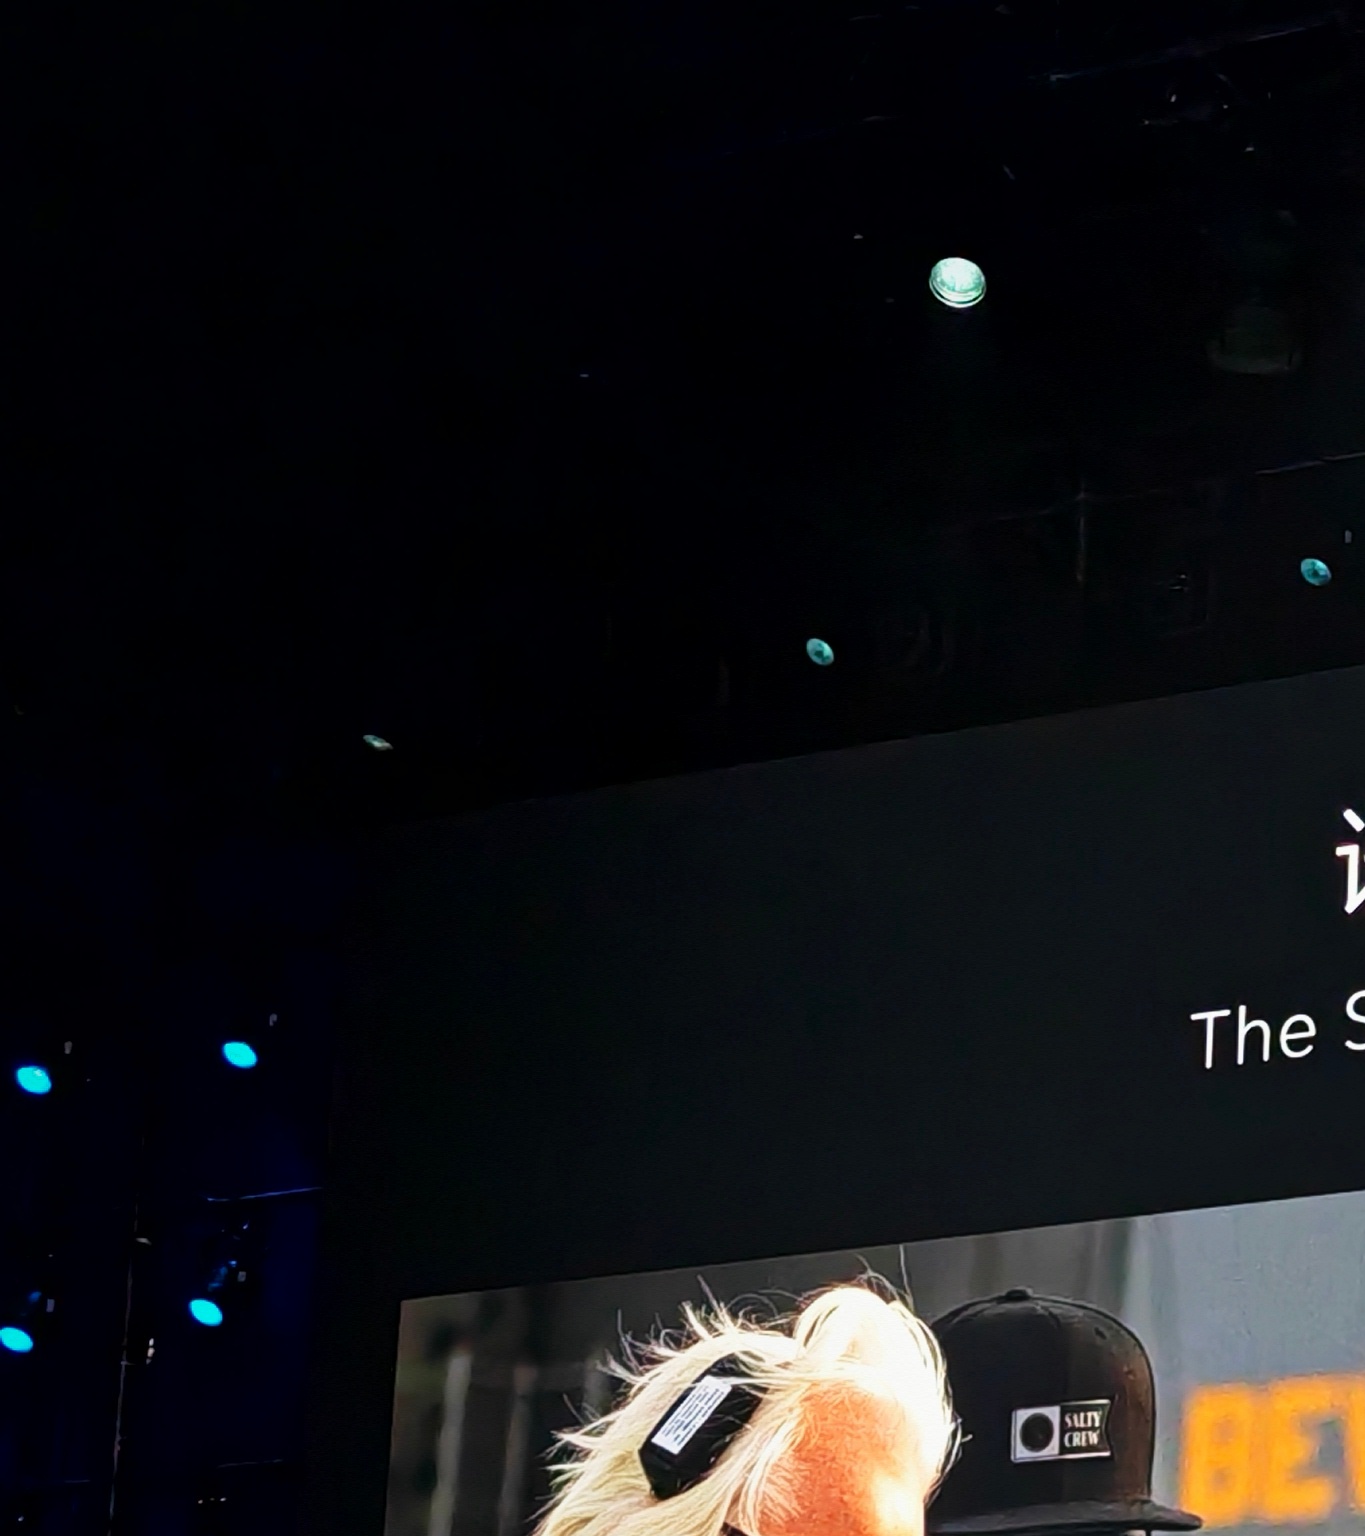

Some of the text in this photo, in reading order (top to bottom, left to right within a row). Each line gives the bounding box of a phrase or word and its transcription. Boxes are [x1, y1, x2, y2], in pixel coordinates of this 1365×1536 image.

[1190, 1004, 1317, 1070] The
[1064, 1411, 1102, 1428] SALTY
[1063, 1430, 1100, 1447] CREW
